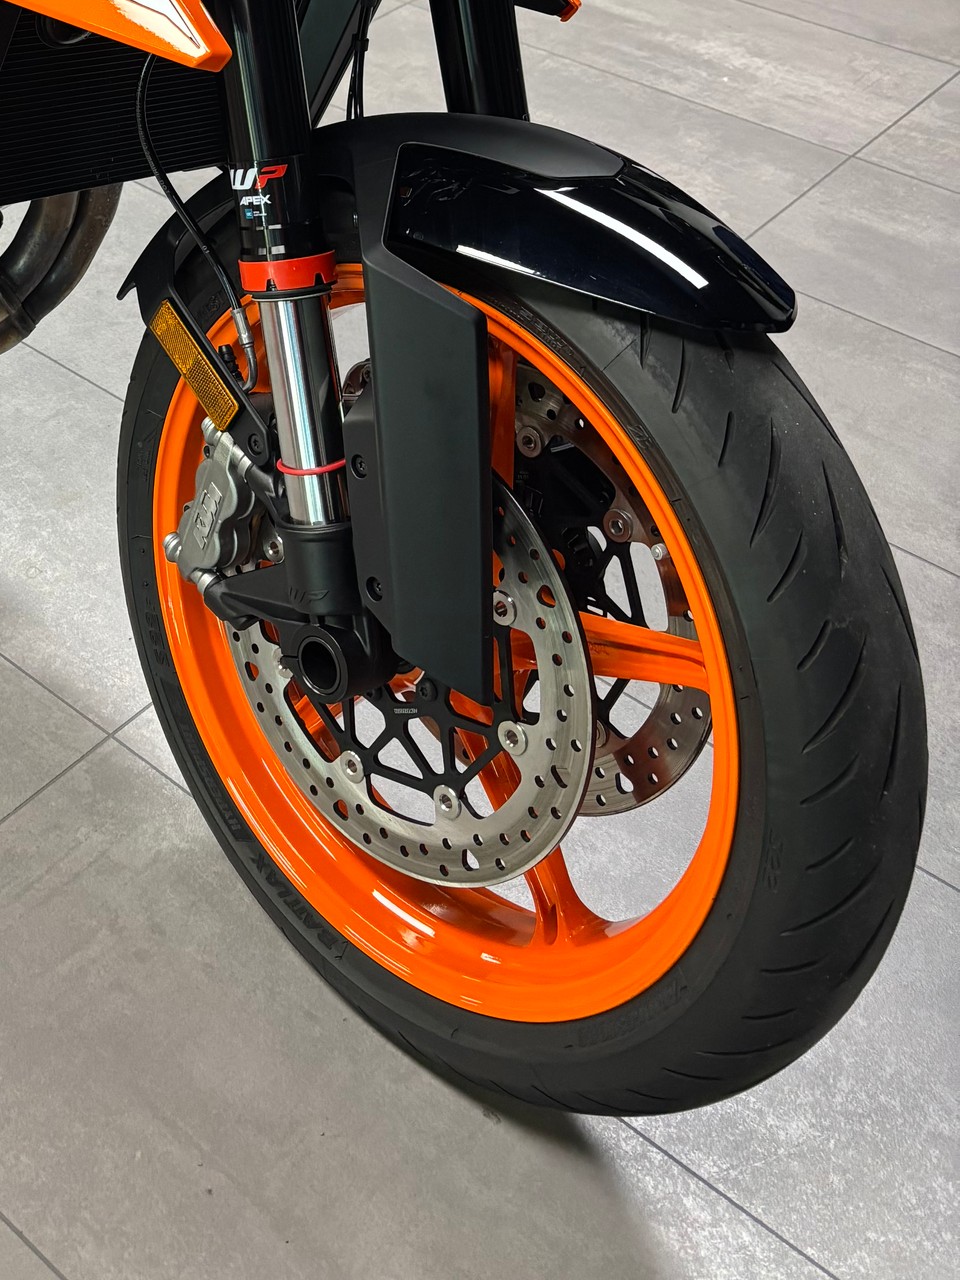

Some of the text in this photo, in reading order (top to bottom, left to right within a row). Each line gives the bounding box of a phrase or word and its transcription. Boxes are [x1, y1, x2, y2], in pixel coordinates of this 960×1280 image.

[230, 164, 288, 191] WP
[239, 194, 272, 207] APEX
[193, 481, 224, 551] KTM
[248, 852, 339, 951] BATTLAX
